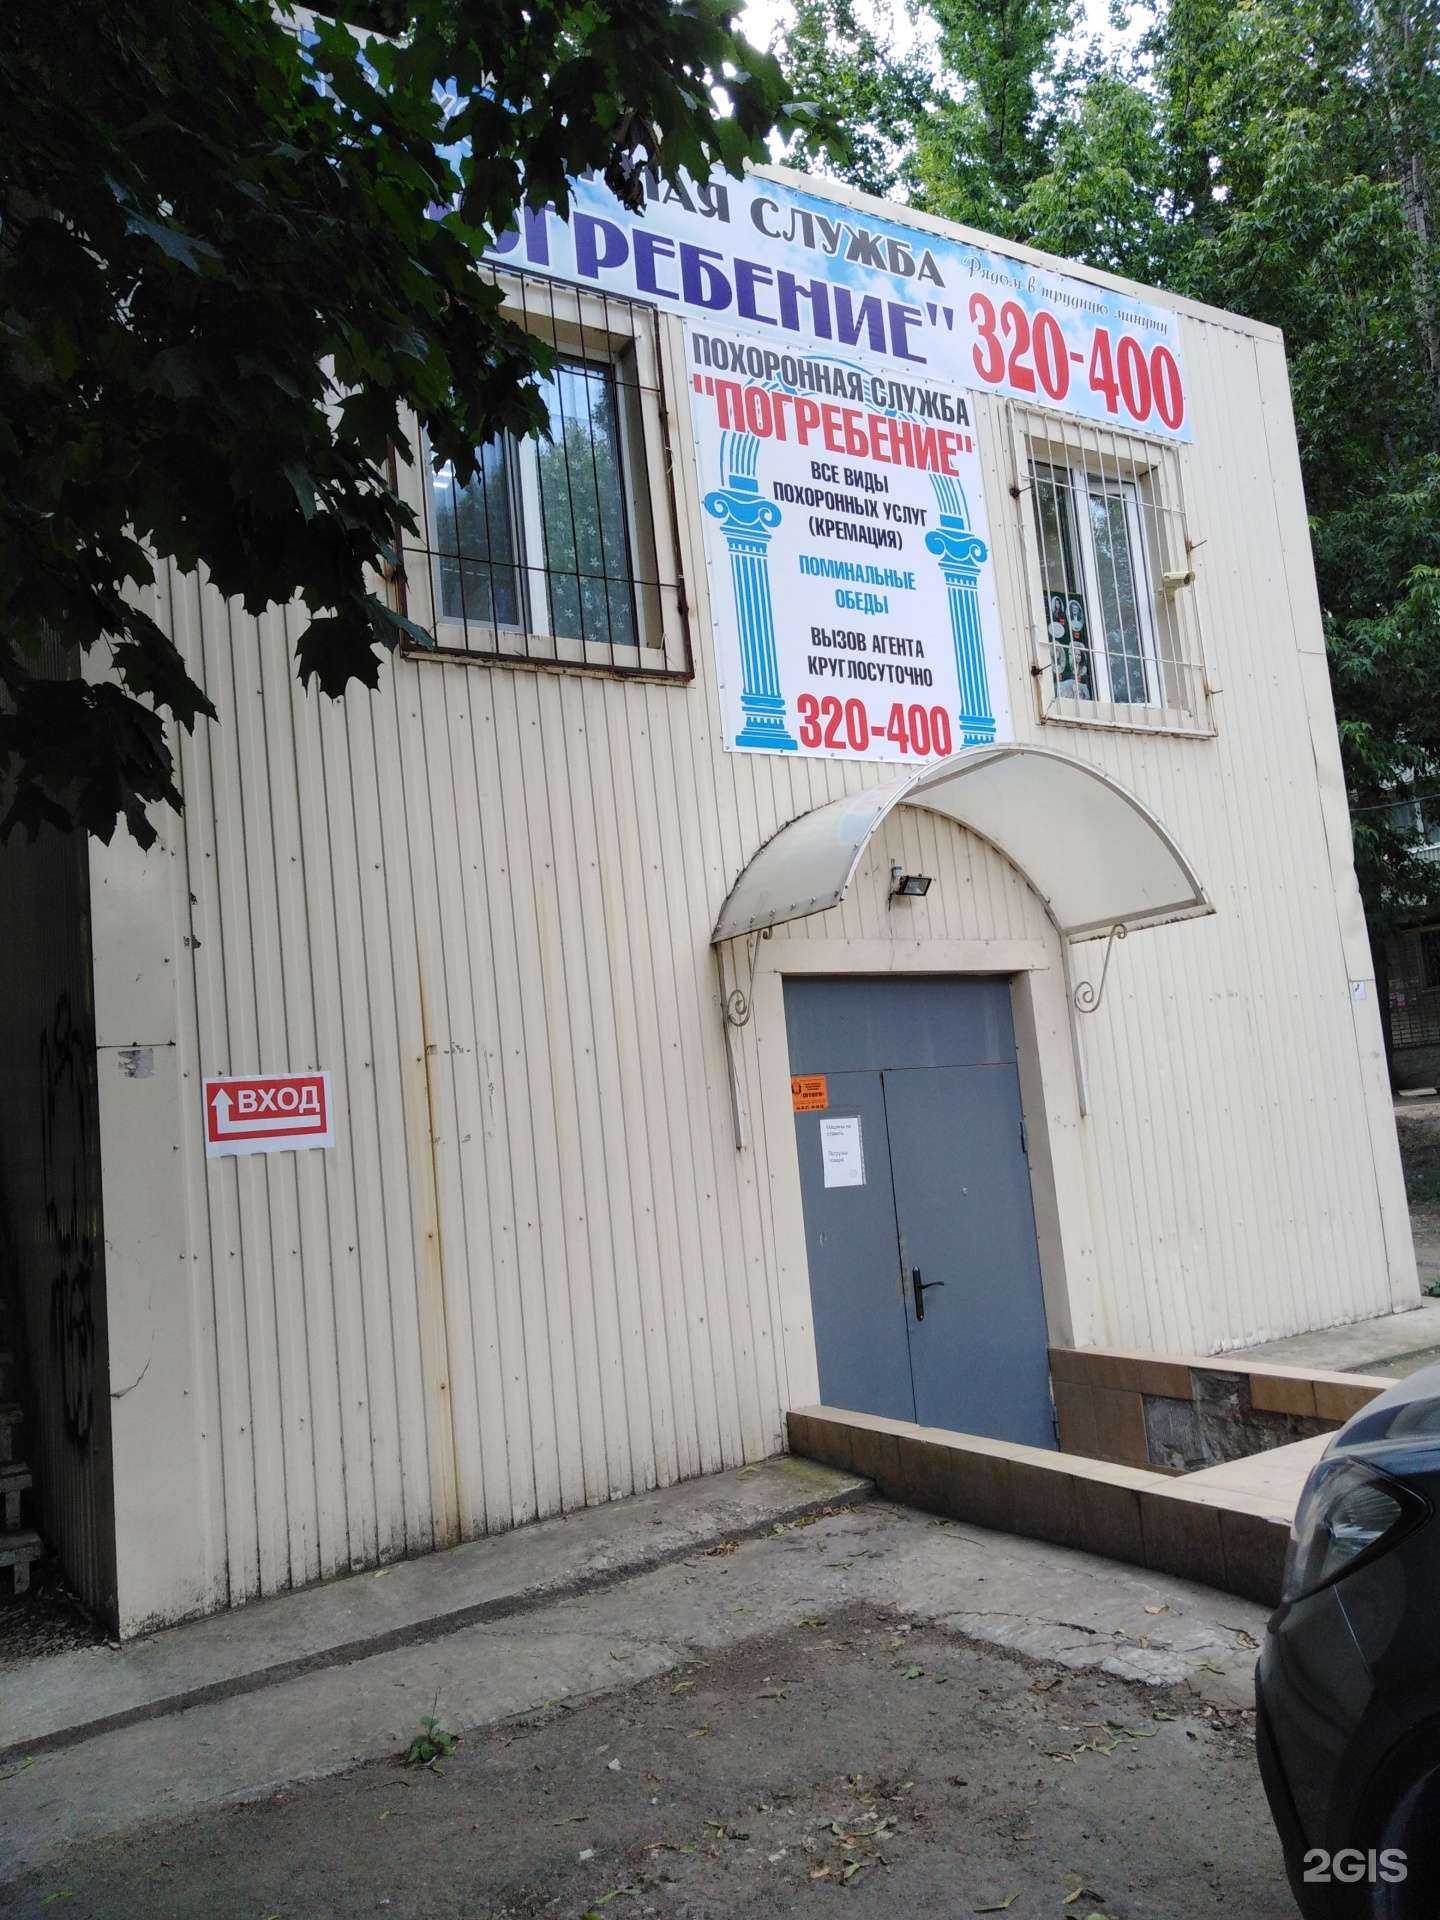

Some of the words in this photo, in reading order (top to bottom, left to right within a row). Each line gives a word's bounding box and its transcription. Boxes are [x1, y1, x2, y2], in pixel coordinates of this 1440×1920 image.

[750, 197, 946, 289] СЛУЖБА
[428, 199, 955, 365] ГРЕБЕНИЕ"
[964, 255, 1022, 290] Рядом
[1028, 275, 1036, 293] в
[692, 332, 864, 403] ПОХОРОННАЯ
[870, 376, 971, 427] СЛУЖБА
[968, 292, 1184, 430] 320-400
[693, 373, 973, 477] "ПОГРЕБЕНИЕ"
[810, 460, 840, 484] ВСЕ
[844, 466, 889, 494] ВИДЫ
[772, 481, 879, 519] ПОХОРОННЫХ
[883, 503, 928, 527] УСЛУГ
[808, 516, 903, 551] (КРЕМАЦИЯ)
[798, 555, 917, 591] ПОМИНАЛЬНЫЕ
[834, 588, 889, 616] ОБЕДЫ
[811, 626, 867, 652] ВЫЗОВ
[872, 634, 925, 659] АГЕНТА
[807, 655, 933, 688] КРУГЛОСУТОЧНО
[797, 693, 953, 758] 320-400
[238, 1085, 320, 1114] ВХОД
